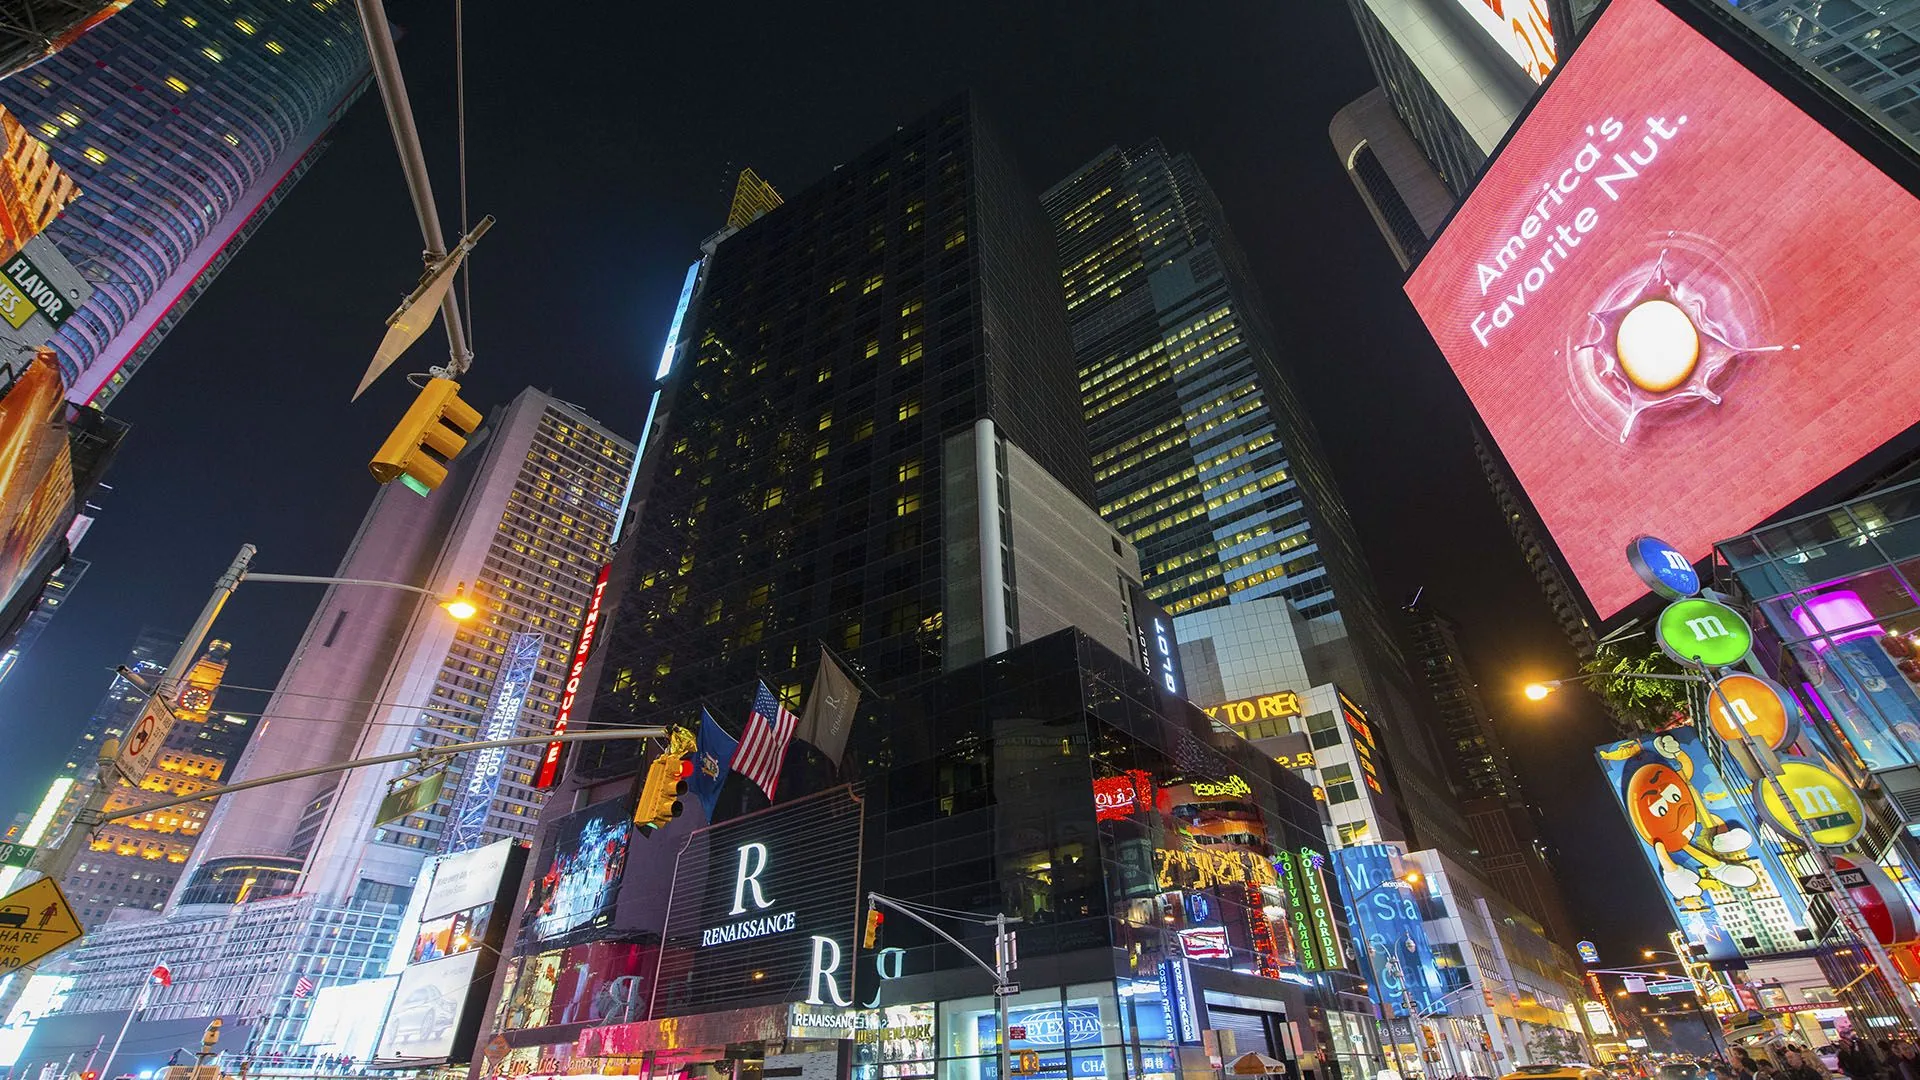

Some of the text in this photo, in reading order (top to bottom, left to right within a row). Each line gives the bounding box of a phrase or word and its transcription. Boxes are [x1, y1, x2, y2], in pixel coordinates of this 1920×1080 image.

[1477, 116, 1624, 296] America's
[1470, 207, 1599, 348] Favorite
[1594, 114, 1688, 201] Nut.
[7, 258, 63, 322] FLAVOR.
[1660, 550, 1692, 572] m
[577, 581, 607, 655] TIMES
[1685, 615, 1730, 641] m
[469, 681, 515, 794] AMERIAN EAGLE
[487, 697, 520, 776] OUTITTERS
[1793, 785, 1841, 814] m
[1821, 817, 1831, 828] 7
[17, 846, 32, 858] ST
[728, 842, 776, 916] R
[1811, 877, 1832, 889] ONE
[1302, 858, 1338, 968] OLIVE GARDEN
[0, 929, 42, 944] HARE
[701, 911, 797, 947] RENAISSANCE
[0, 957, 21, 969] AD
[804, 935, 854, 1007] R
[1172, 960, 1184, 994] MONEY
[795, 1013, 859, 1029] RENAISSANCE
[904, 1023, 931, 1041] YORK
[1047, 1019, 1101, 1034] EXCHAN
